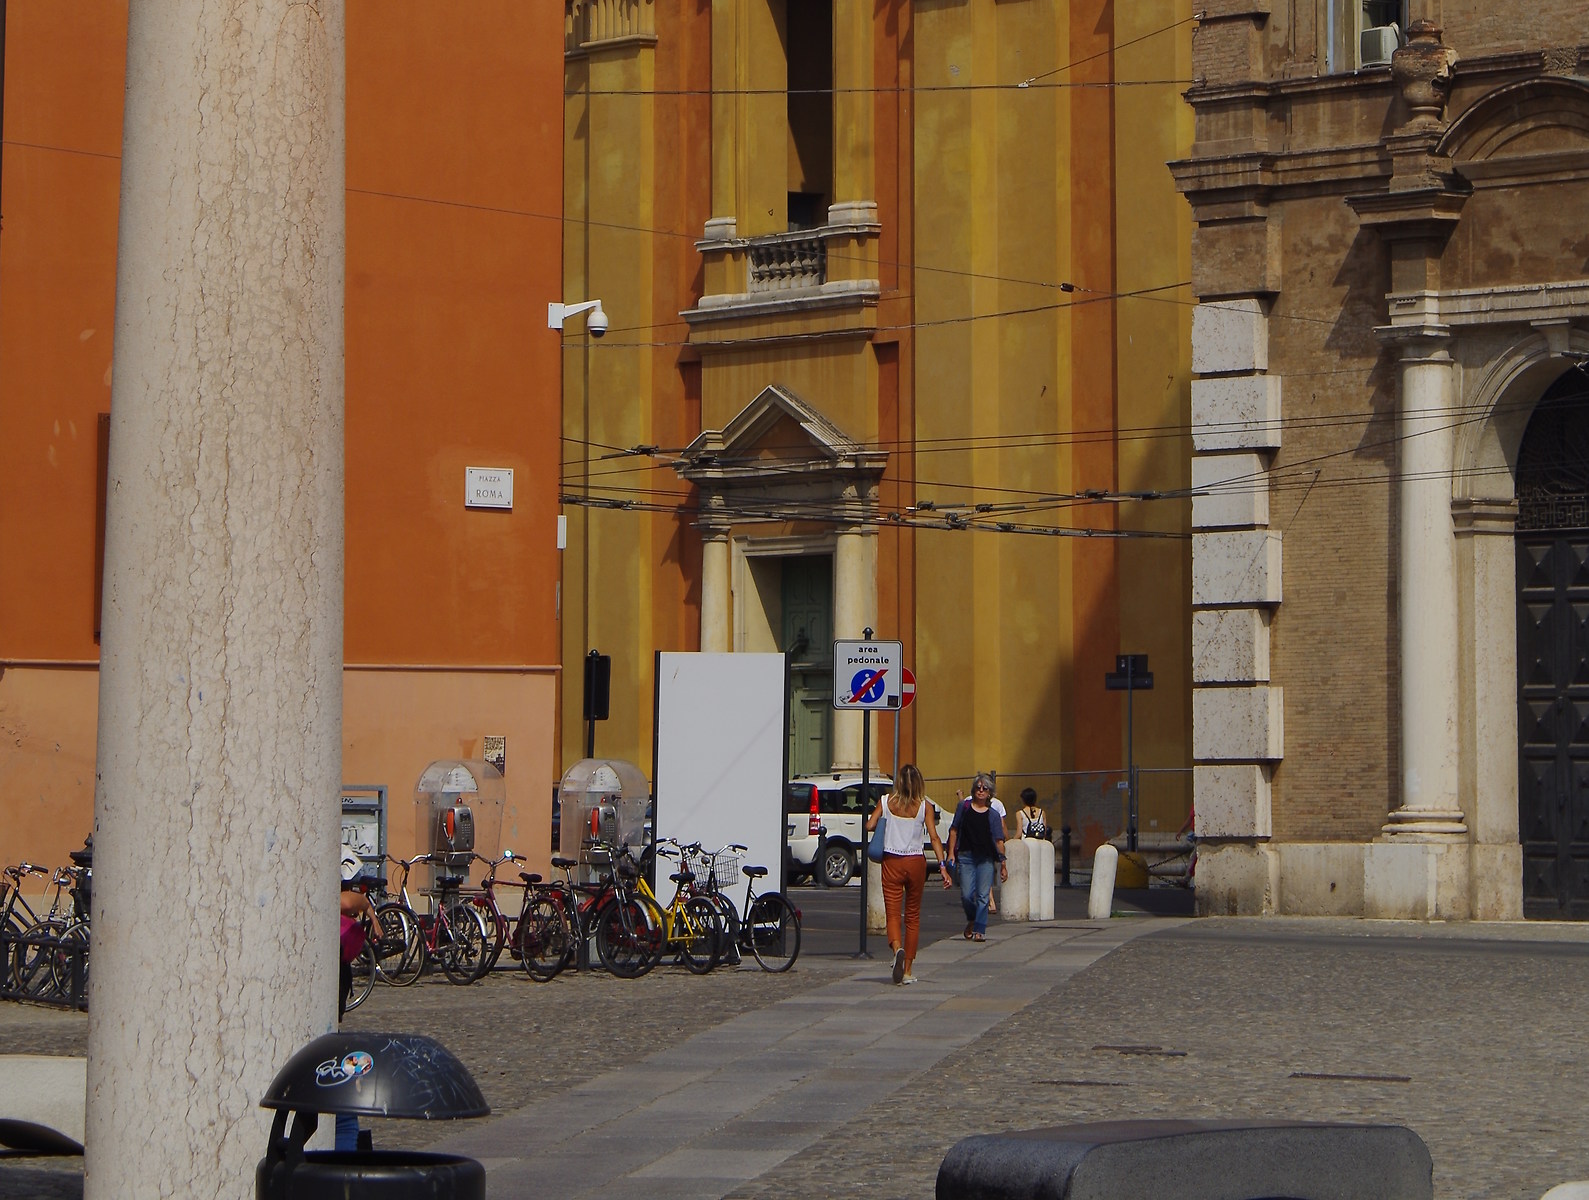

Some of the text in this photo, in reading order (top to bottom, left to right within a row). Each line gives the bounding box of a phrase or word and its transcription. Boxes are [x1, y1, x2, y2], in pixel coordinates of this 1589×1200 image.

[478, 475, 501, 483] PIAZZA
[476, 489, 503, 499] ROMA
[847, 656, 890, 665] pedonale
